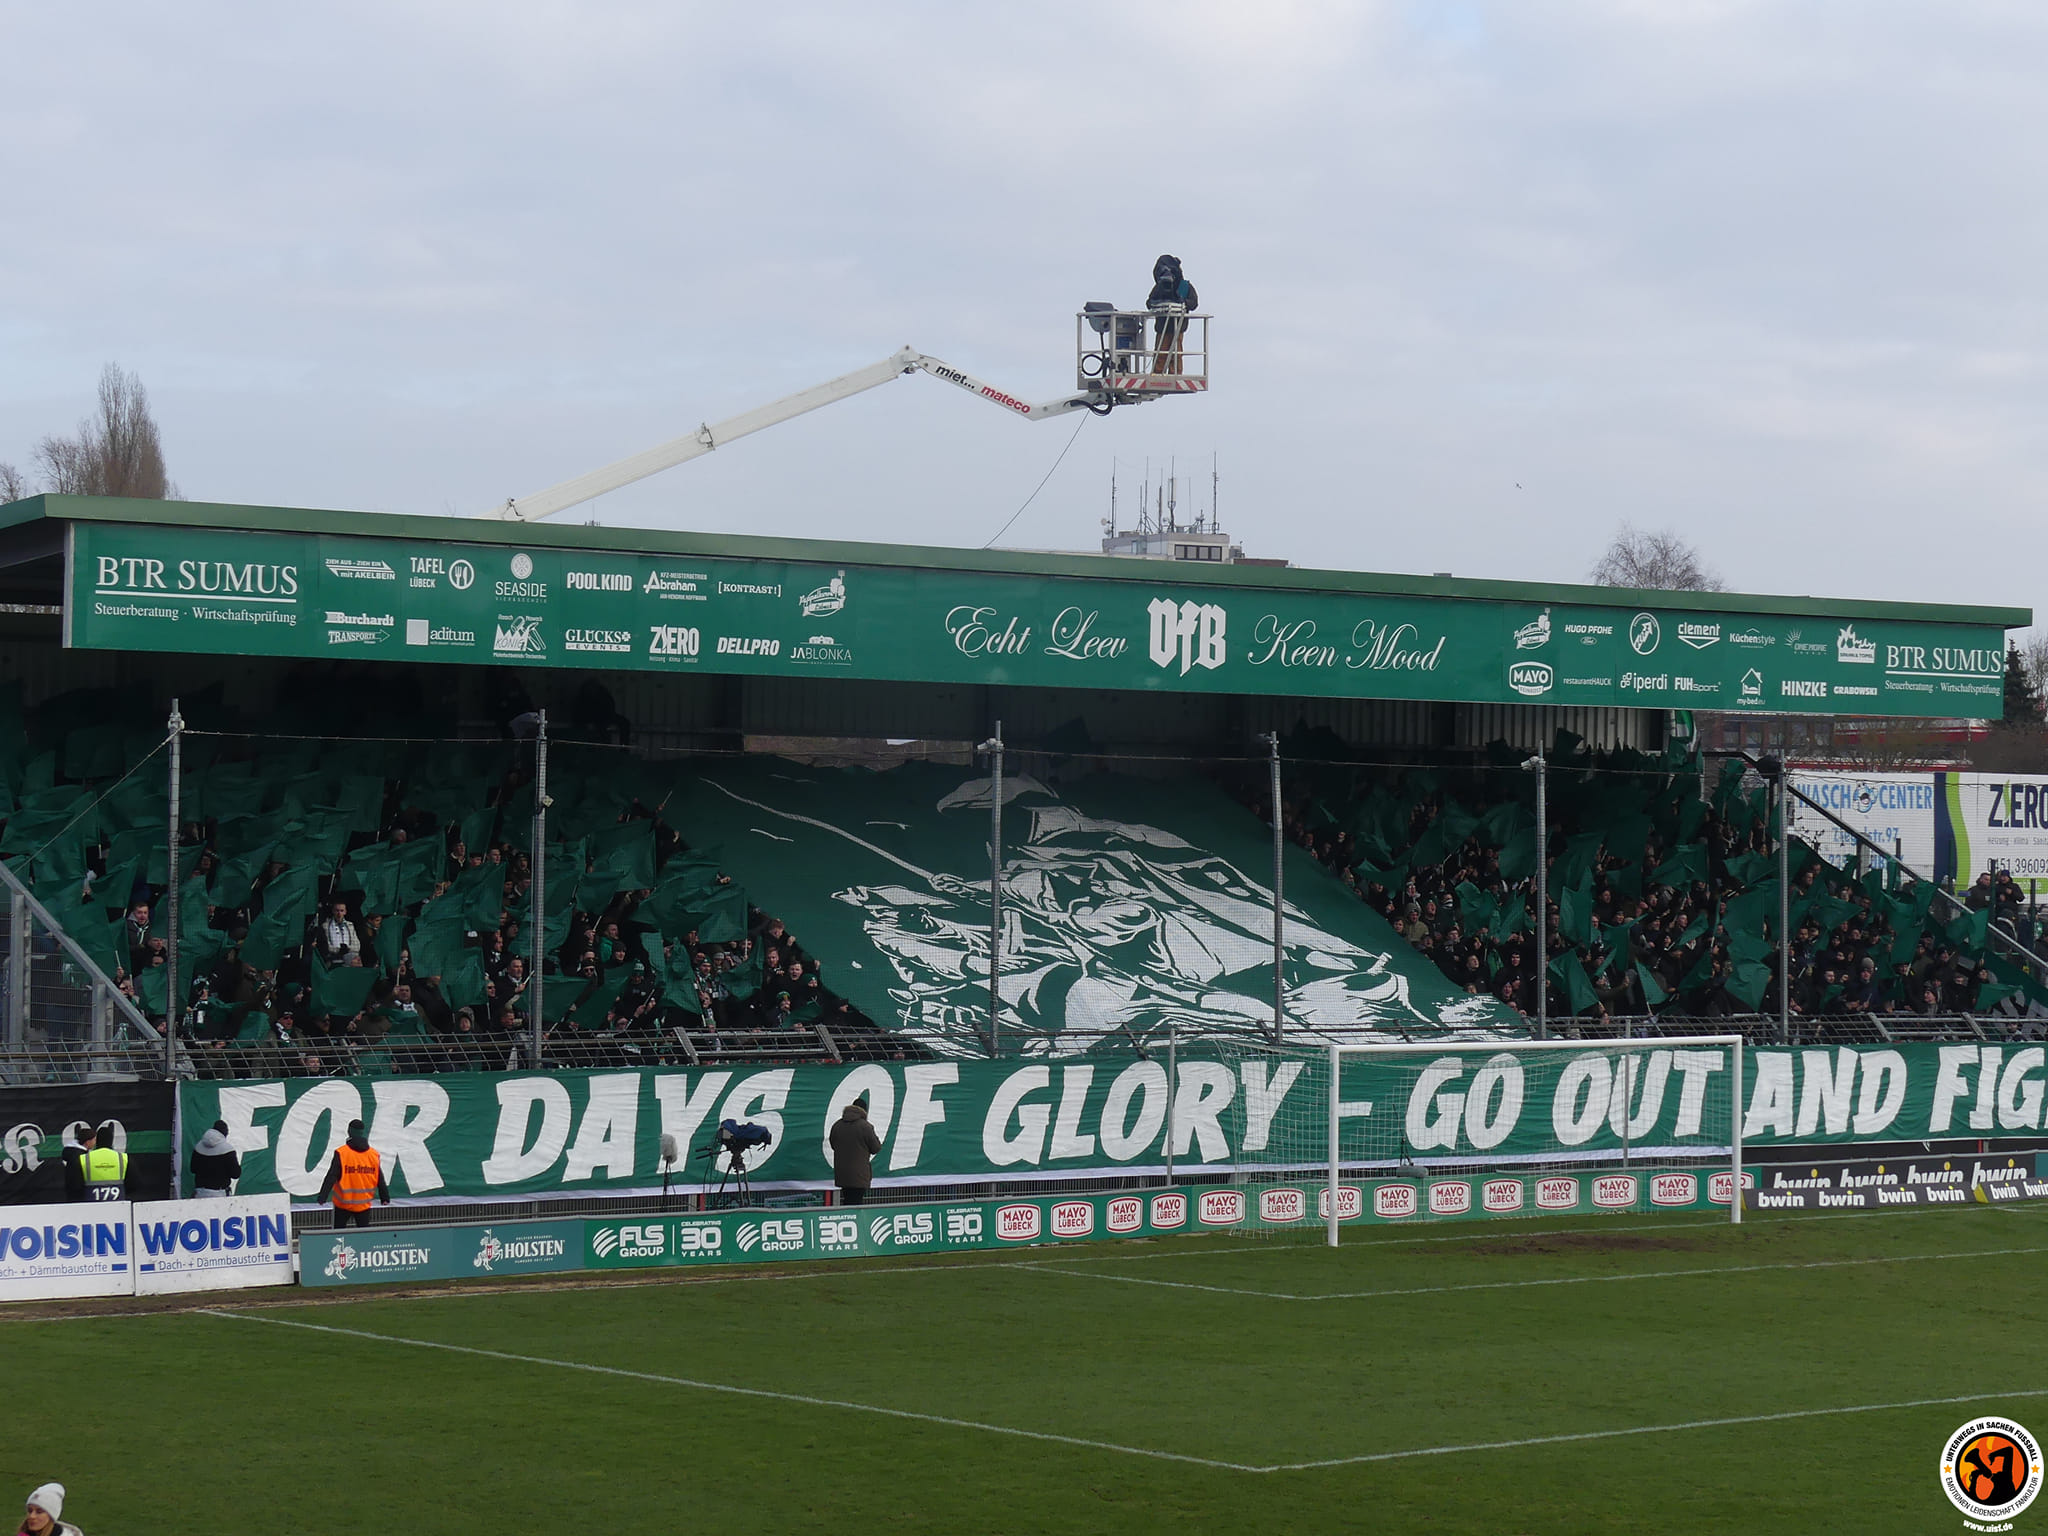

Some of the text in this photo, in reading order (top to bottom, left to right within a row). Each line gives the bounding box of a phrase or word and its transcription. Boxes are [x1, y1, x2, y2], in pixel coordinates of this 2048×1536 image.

[981, 386, 1031, 414] mateco
[410, 557, 446, 574] TAFEL
[96, 556, 299, 596] BTR SUMUS
[410, 576, 437, 589] LÜBECK
[643, 570, 697, 594] Abraham
[495, 581, 548, 598] SEASIDE
[95, 602, 297, 627] Steuerberatung Wirtschaftsprüfung
[430, 626, 476, 642] aditum
[1565, 624, 1613, 634] HUGO PFOHE
[1678, 621, 1721, 636] clement
[565, 629, 622, 643] GLÜCKS
[944, 605, 1032, 658] Echt
[1044, 605, 1129, 660] Leev
[1247, 614, 1339, 667] Keen
[1345, 618, 1447, 671] Mood
[1729, 632, 1776, 647] Küchenstyle
[575, 643, 621, 651] EVENTS
[717, 637, 780, 656] DELLPRO
[790, 647, 852, 661] JABLONKA
[1886, 645, 2002, 673] BTR SUMUS
[1513, 669, 1549, 684] MAYO
[1633, 673, 1668, 693] iperdi
[1781, 680, 1828, 697] HINZKE
[1833, 686, 1878, 696] GRABOWSKI
[1885, 680, 2001, 697] Steuerberatung Wirtschaftsprüfung
[1879, 785, 1933, 809] CENTER
[219, 1079, 450, 1197] FOR
[481, 1068, 795, 1186] DAYS
[821, 1062, 959, 1172] OF
[981, 1060, 1307, 1166] GLORY
[1405, 1052, 1525, 1150] GO
[1552, 1050, 1724, 1147] OUT
[1742, 1046, 1907, 1139] AND
[1928, 1044, 2048, 1132] FIG
[1773, 1158, 2027, 1191] bwin bwin bwin bwin
[1488, 1184, 1516, 1196] MAYO
[1542, 1182, 1571, 1194] MAYO
[1599, 1180, 1629, 1192] MAYO
[1658, 1178, 1689, 1190] MAYO
[1989, 1182, 2020, 1200] bwin
[92, 1187, 120, 1201] 179
[1381, 1189, 1409, 1199] MAYO
[1435, 1186, 1464, 1198] MAYO
[1488, 1193, 1516, 1203] LÜBECK
[1542, 1191, 1571, 1201] LÜBECK
[1600, 1189, 1628, 1199] LÜBECK
[1658, 1187, 1689, 1198] LÜBECK
[1758, 1185, 1965, 1207] bwin bwin bwin bwin
[1156, 1199, 1181, 1211] MAYO
[1206, 1195, 1237, 1207] MAYO
[1267, 1194, 1298, 1206] MAYO
[1381, 1199, 1409, 1209] LÜBECK
[1436, 1196, 1464, 1207] LÜBECK
[1003, 1209, 1034, 1221] MAYO
[1058, 1206, 1087, 1218] MAYO
[1113, 1202, 1137, 1215] MAYO
[1156, 1209, 1181, 1220] LÜBECK
[1206, 1205, 1237, 1216] LÜBECK
[1267, 1203, 1297, 1214] LÜBECK
[893, 1213, 983, 1236] FLS 30
[1059, 1216, 1087, 1228] LÜBECK
[1113, 1211, 1137, 1224] LÜBECK
[761, 1219, 858, 1244] FLS 30
[1004, 1219, 1034, 1231] LÜBECK
[139, 1213, 289, 1257] WOISIN
[619, 1225, 722, 1251] FLS 30
[894, 1233, 983, 1245] GROUP YEARS
[504, 1240, 564, 1259] HOLSTEN
[620, 1247, 722, 1258] GROUP YEARS
[762, 1240, 858, 1252] GROUP YEARS
[197, 1252, 271, 1268] Dämmbaustoffe
[360, 1248, 429, 1268] HOLSTEN
[30, 1261, 108, 1277] Dämmbaustoffe
